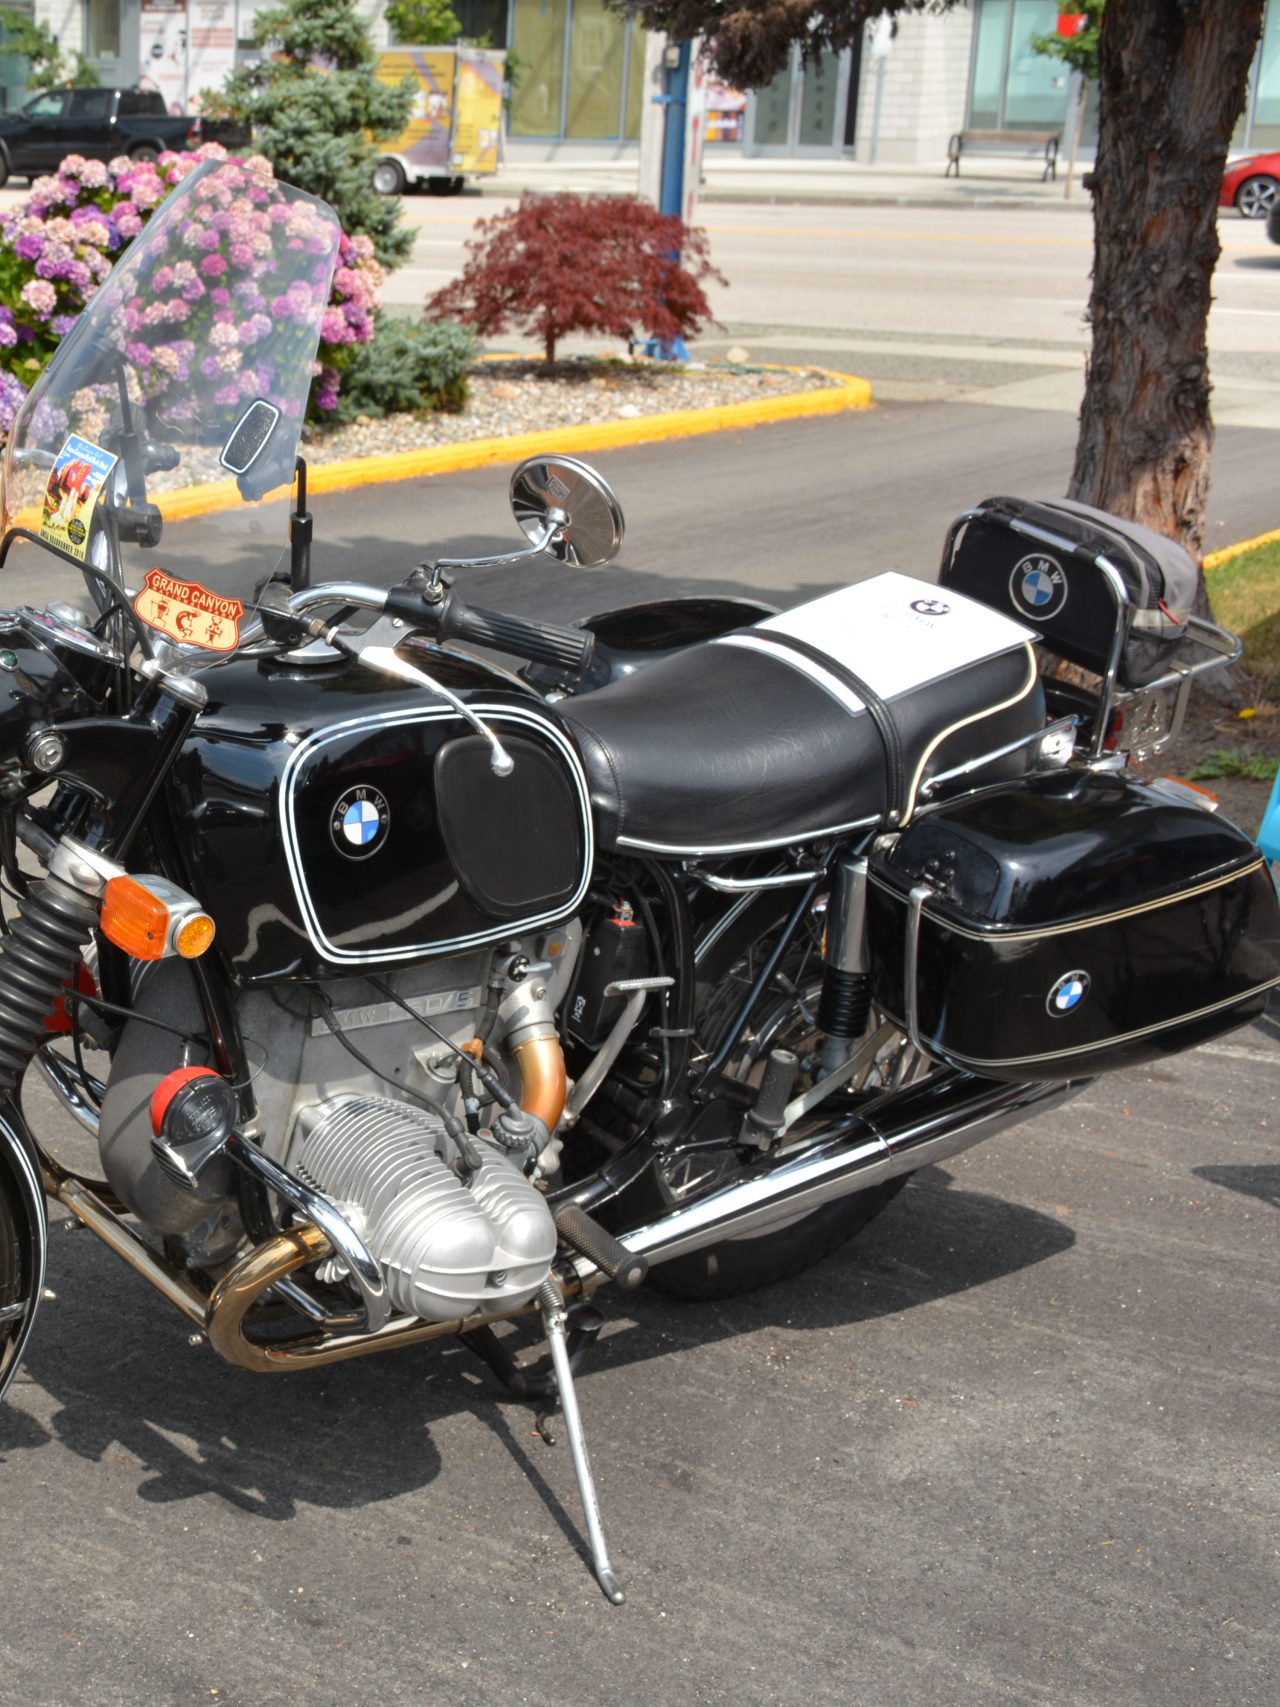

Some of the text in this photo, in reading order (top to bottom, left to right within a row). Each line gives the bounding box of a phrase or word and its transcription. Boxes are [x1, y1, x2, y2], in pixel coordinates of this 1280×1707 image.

[1022, 560, 1062, 584] BMW
[152, 575, 238, 616] GRAND CANYON
[152, 586, 234, 620] NATIONAL PARK
[338, 788, 385, 815] BMW
